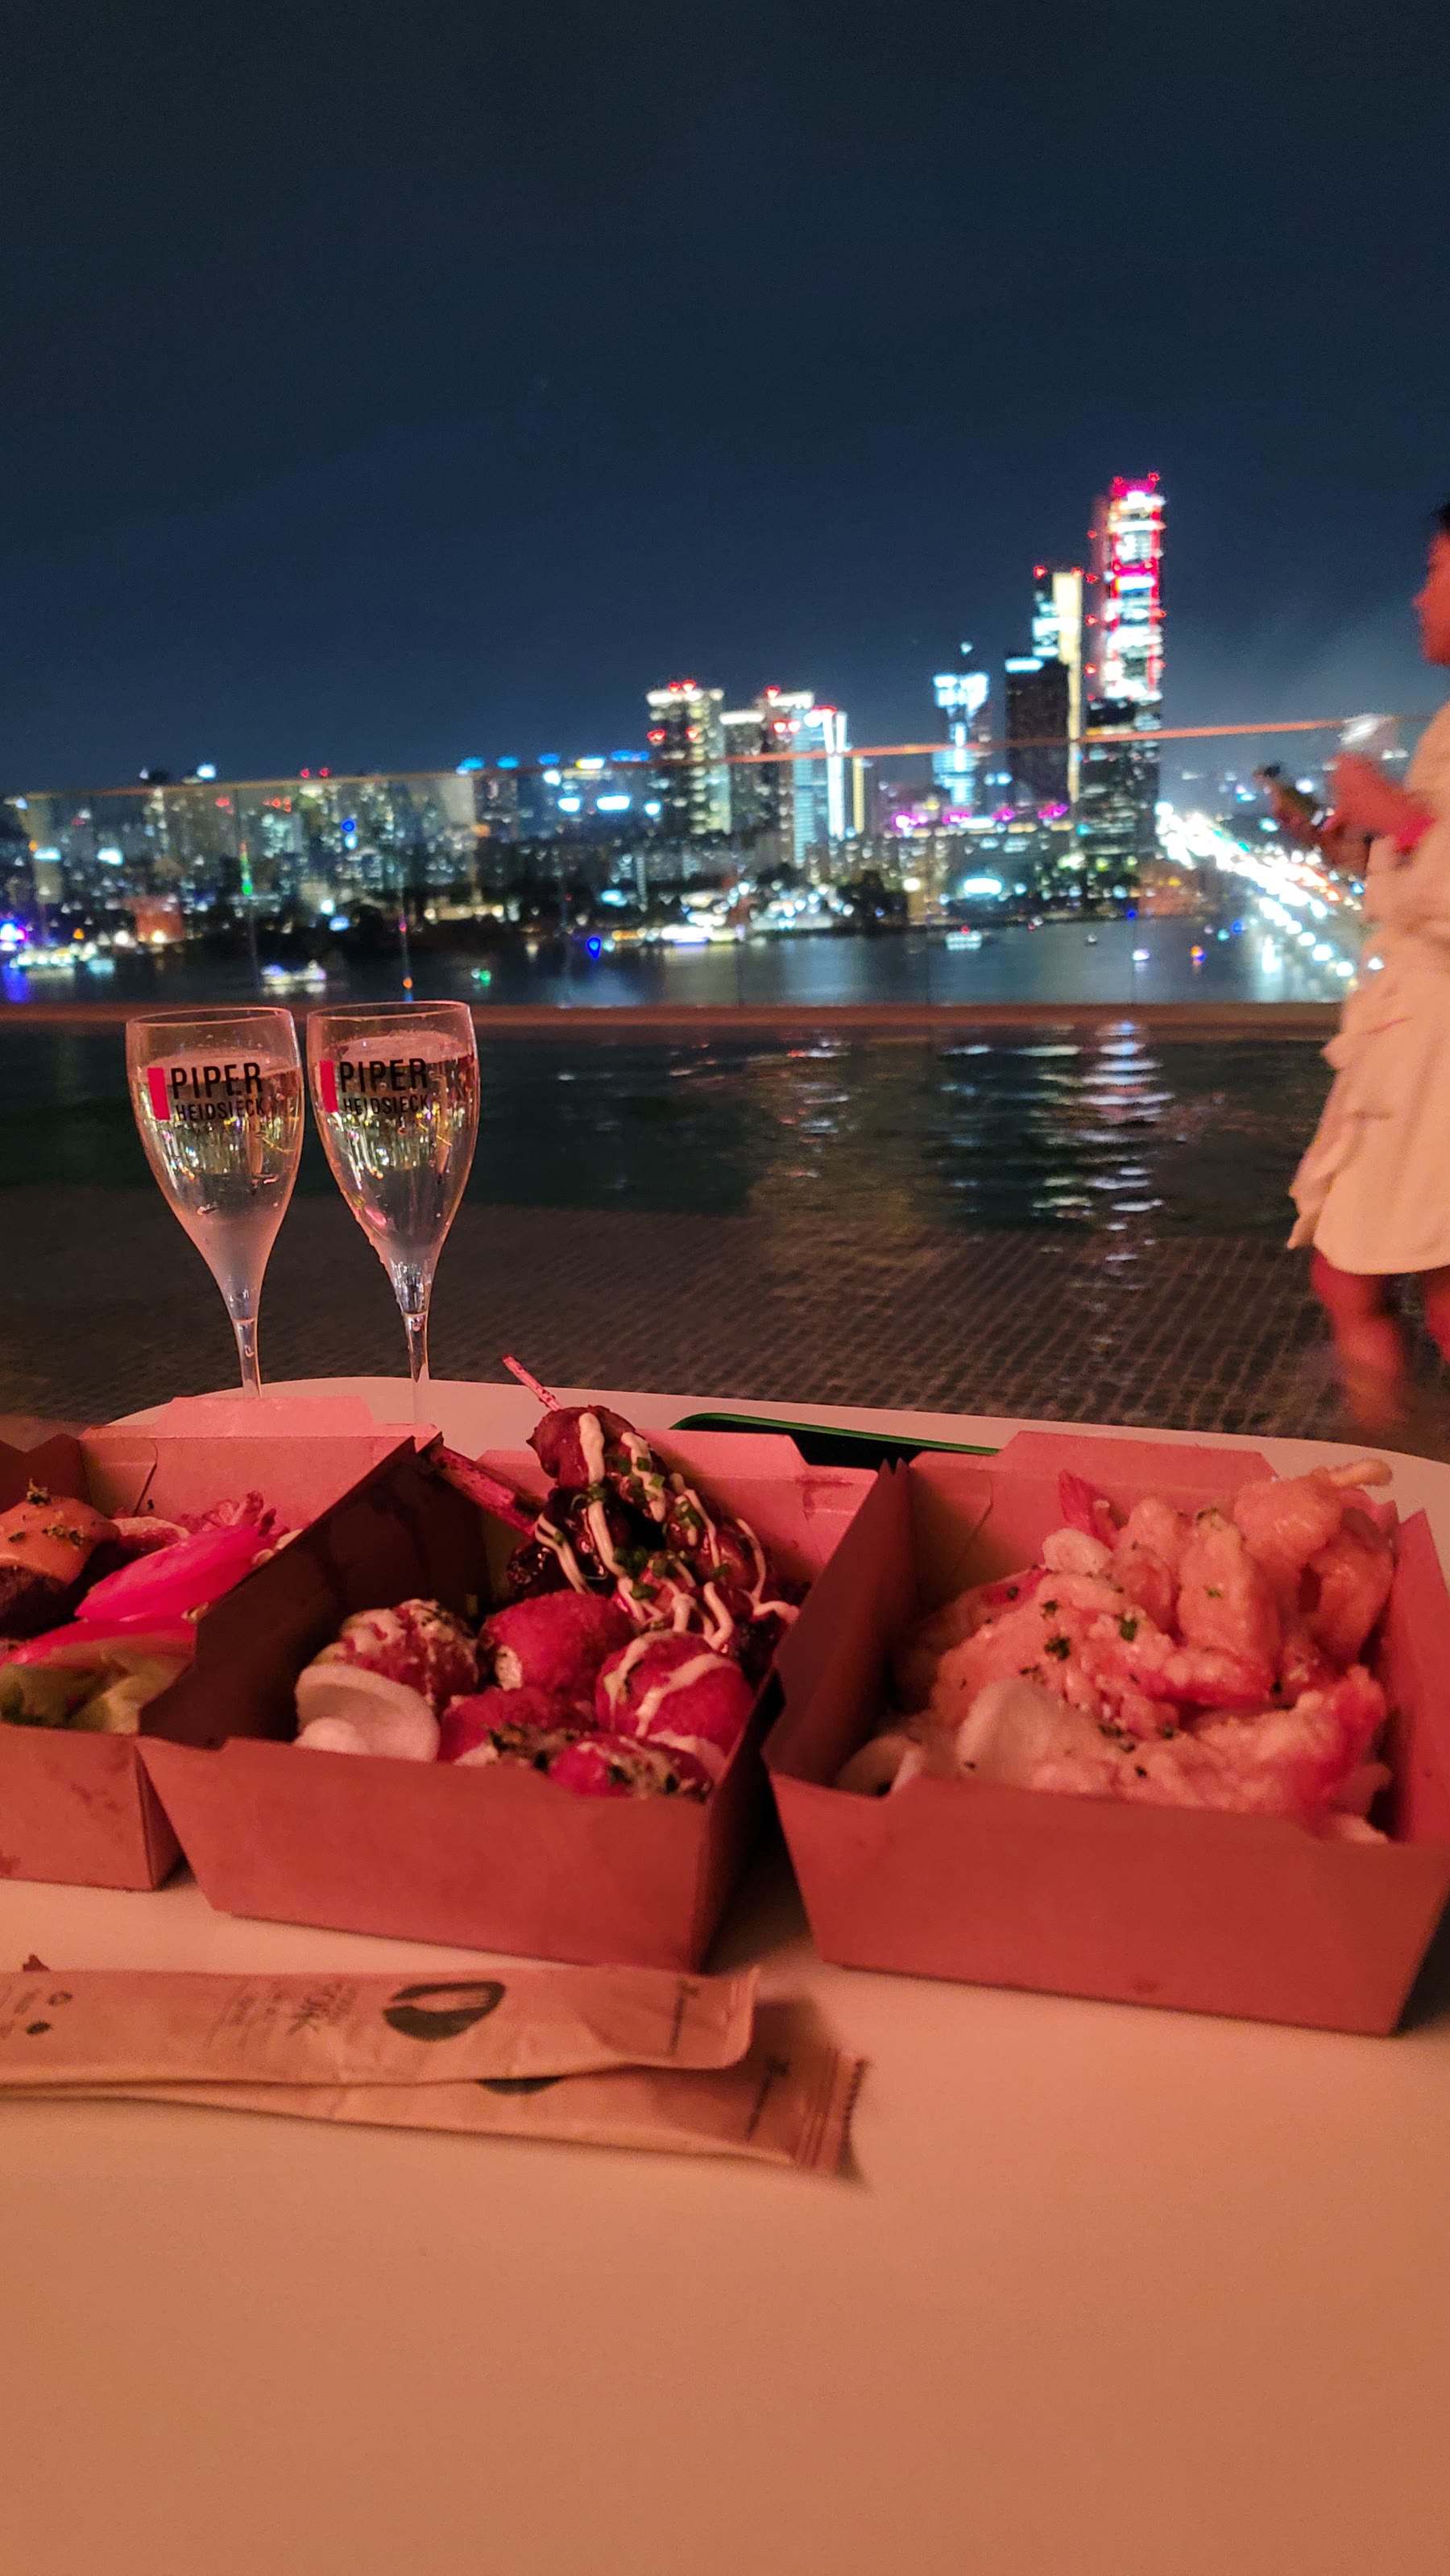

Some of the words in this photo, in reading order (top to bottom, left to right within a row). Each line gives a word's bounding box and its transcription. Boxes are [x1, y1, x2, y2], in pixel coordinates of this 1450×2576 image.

[171, 1062, 263, 1099] PIPER
[339, 1058, 428, 1092] PIPER
[176, 1098, 265, 1121] HEIDSIECK
[343, 1094, 430, 1116] HEIDSIECK
